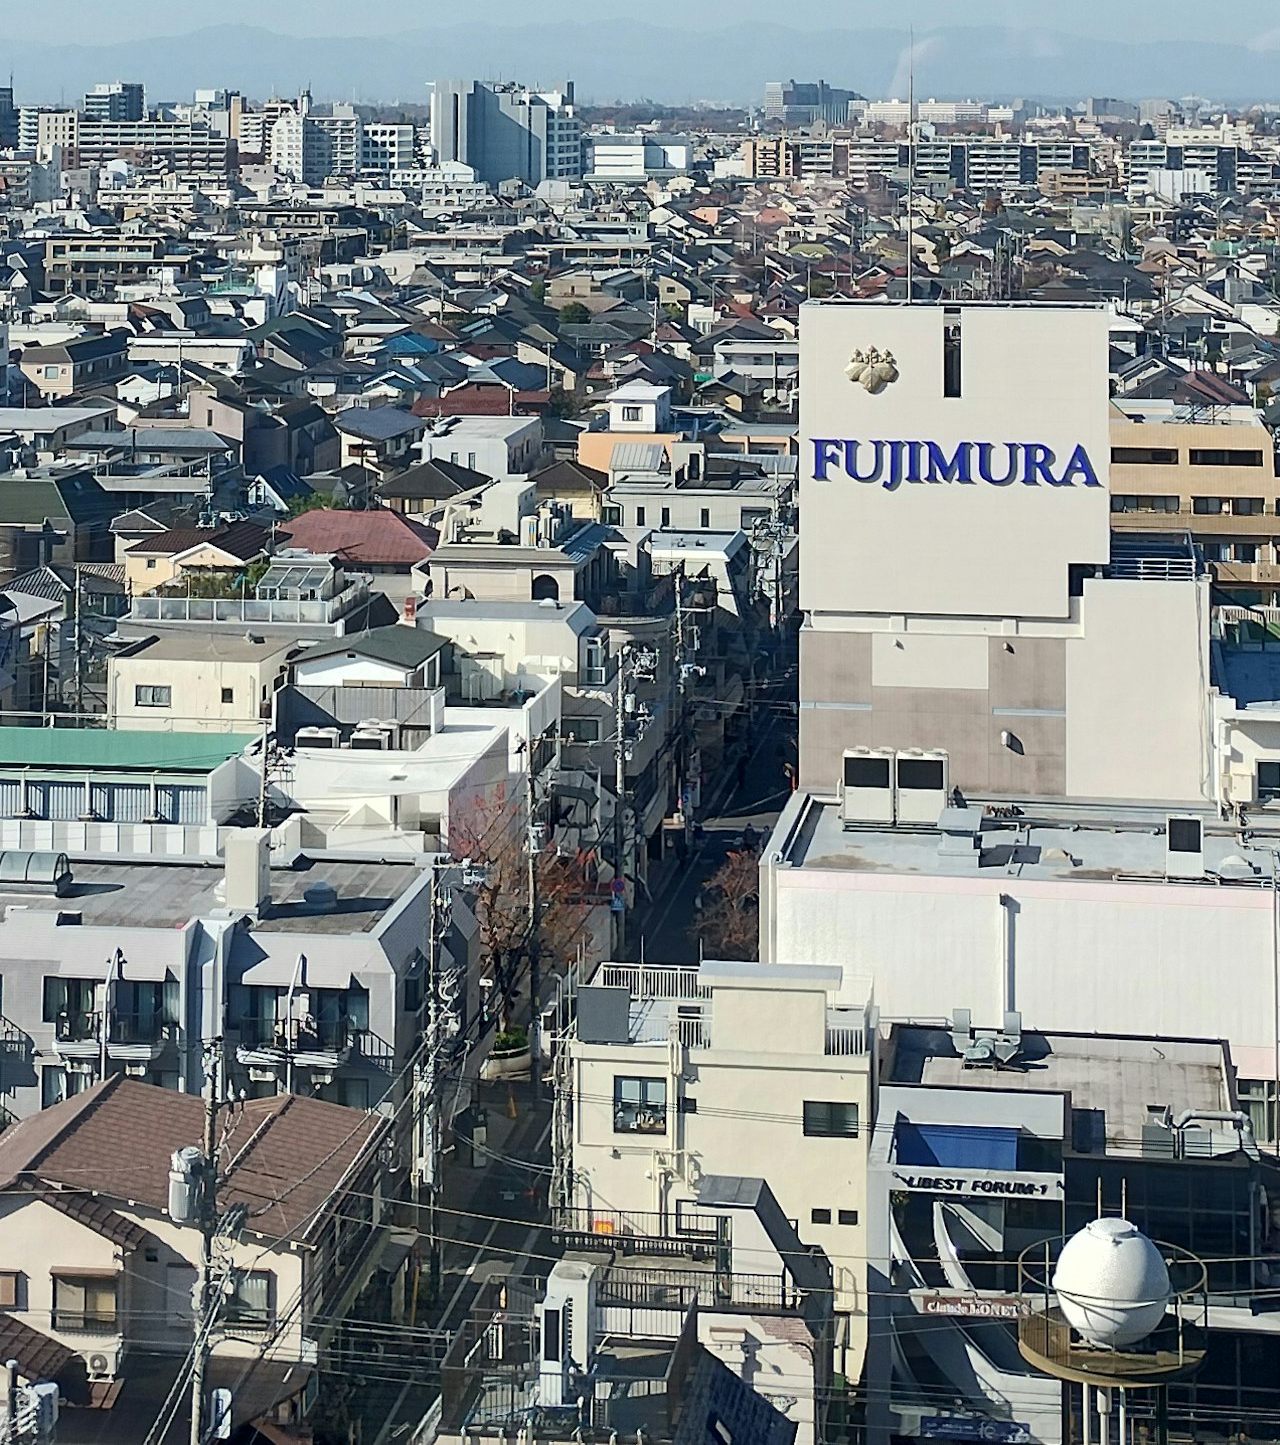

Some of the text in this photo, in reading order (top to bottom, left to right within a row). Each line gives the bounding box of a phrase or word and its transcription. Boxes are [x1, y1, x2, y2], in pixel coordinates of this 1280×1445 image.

[809, 438, 1105, 492] FUJIMURA
[907, 1176, 1049, 1195] LIBEST FORUM-1
